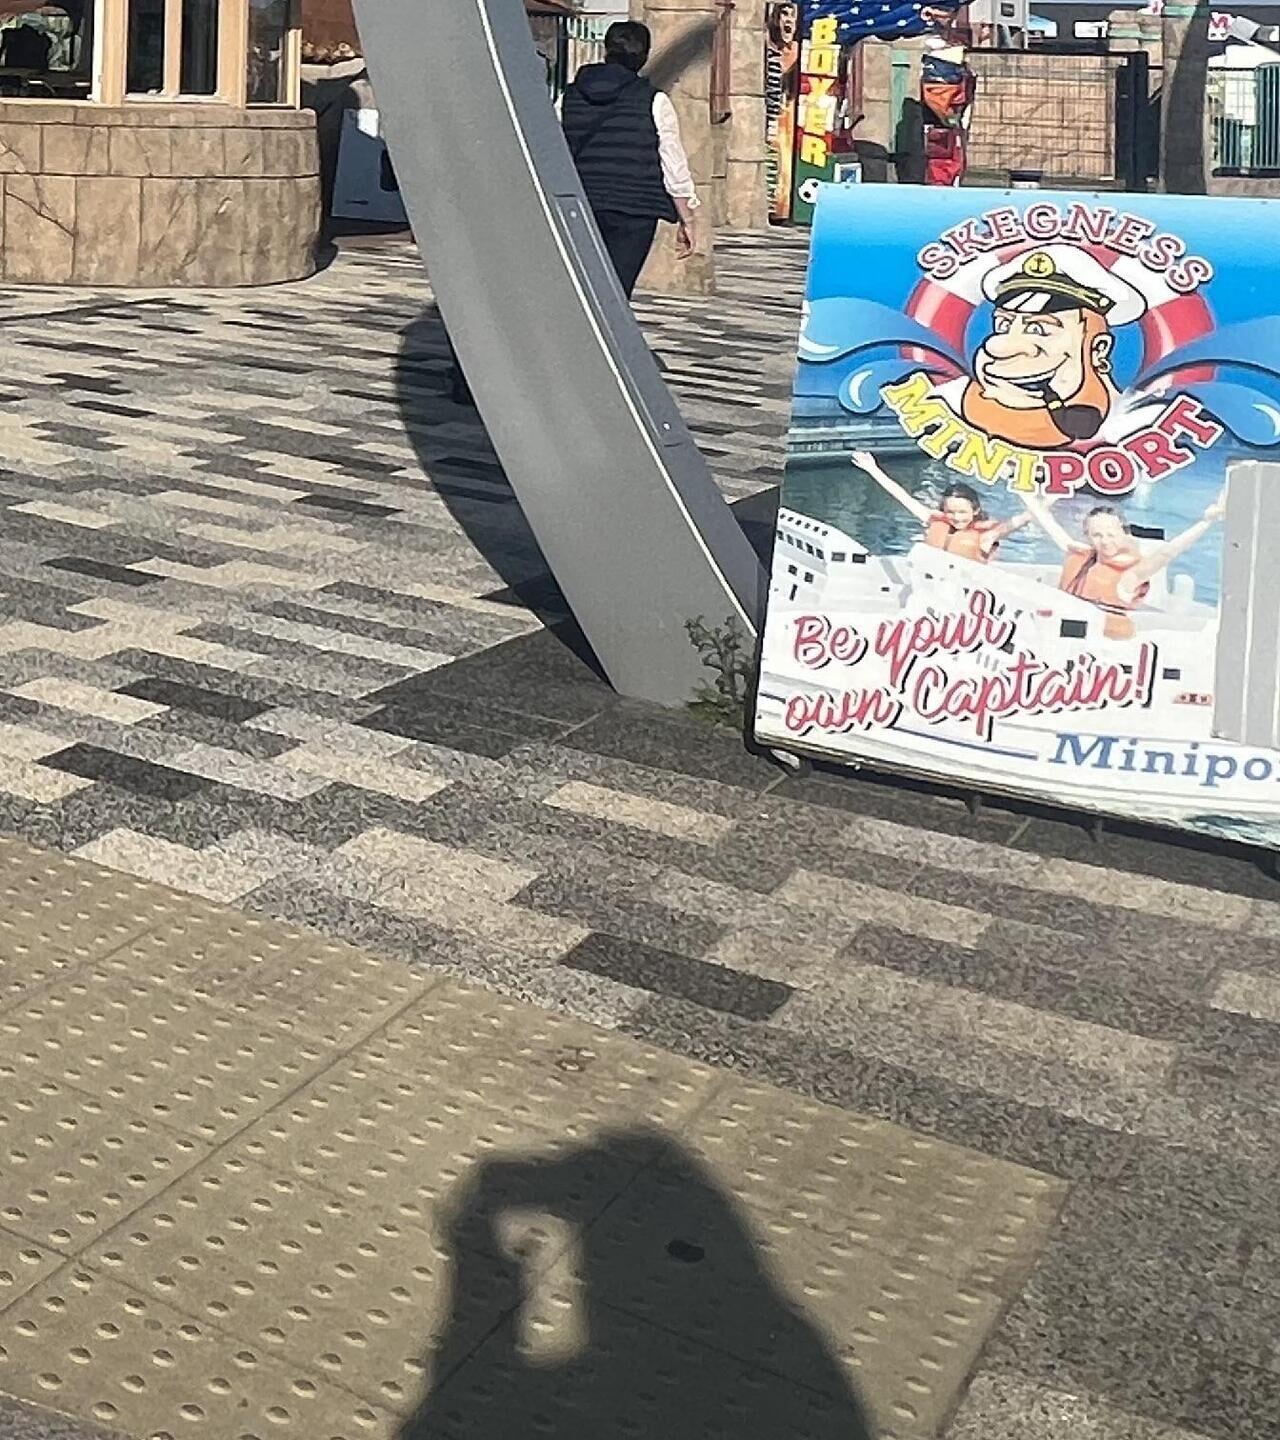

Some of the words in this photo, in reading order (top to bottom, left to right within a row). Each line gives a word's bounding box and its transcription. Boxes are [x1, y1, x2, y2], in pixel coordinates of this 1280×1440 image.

[920, 204, 1212, 293] SKEGNESS
[883, 376, 1223, 495] MINIPORT
[793, 615, 862, 665] Be
[875, 591, 1006, 687] your
[785, 685, 897, 732] own
[913, 643, 1152, 737] Captain!
[1053, 732, 1280, 788] Minipo
